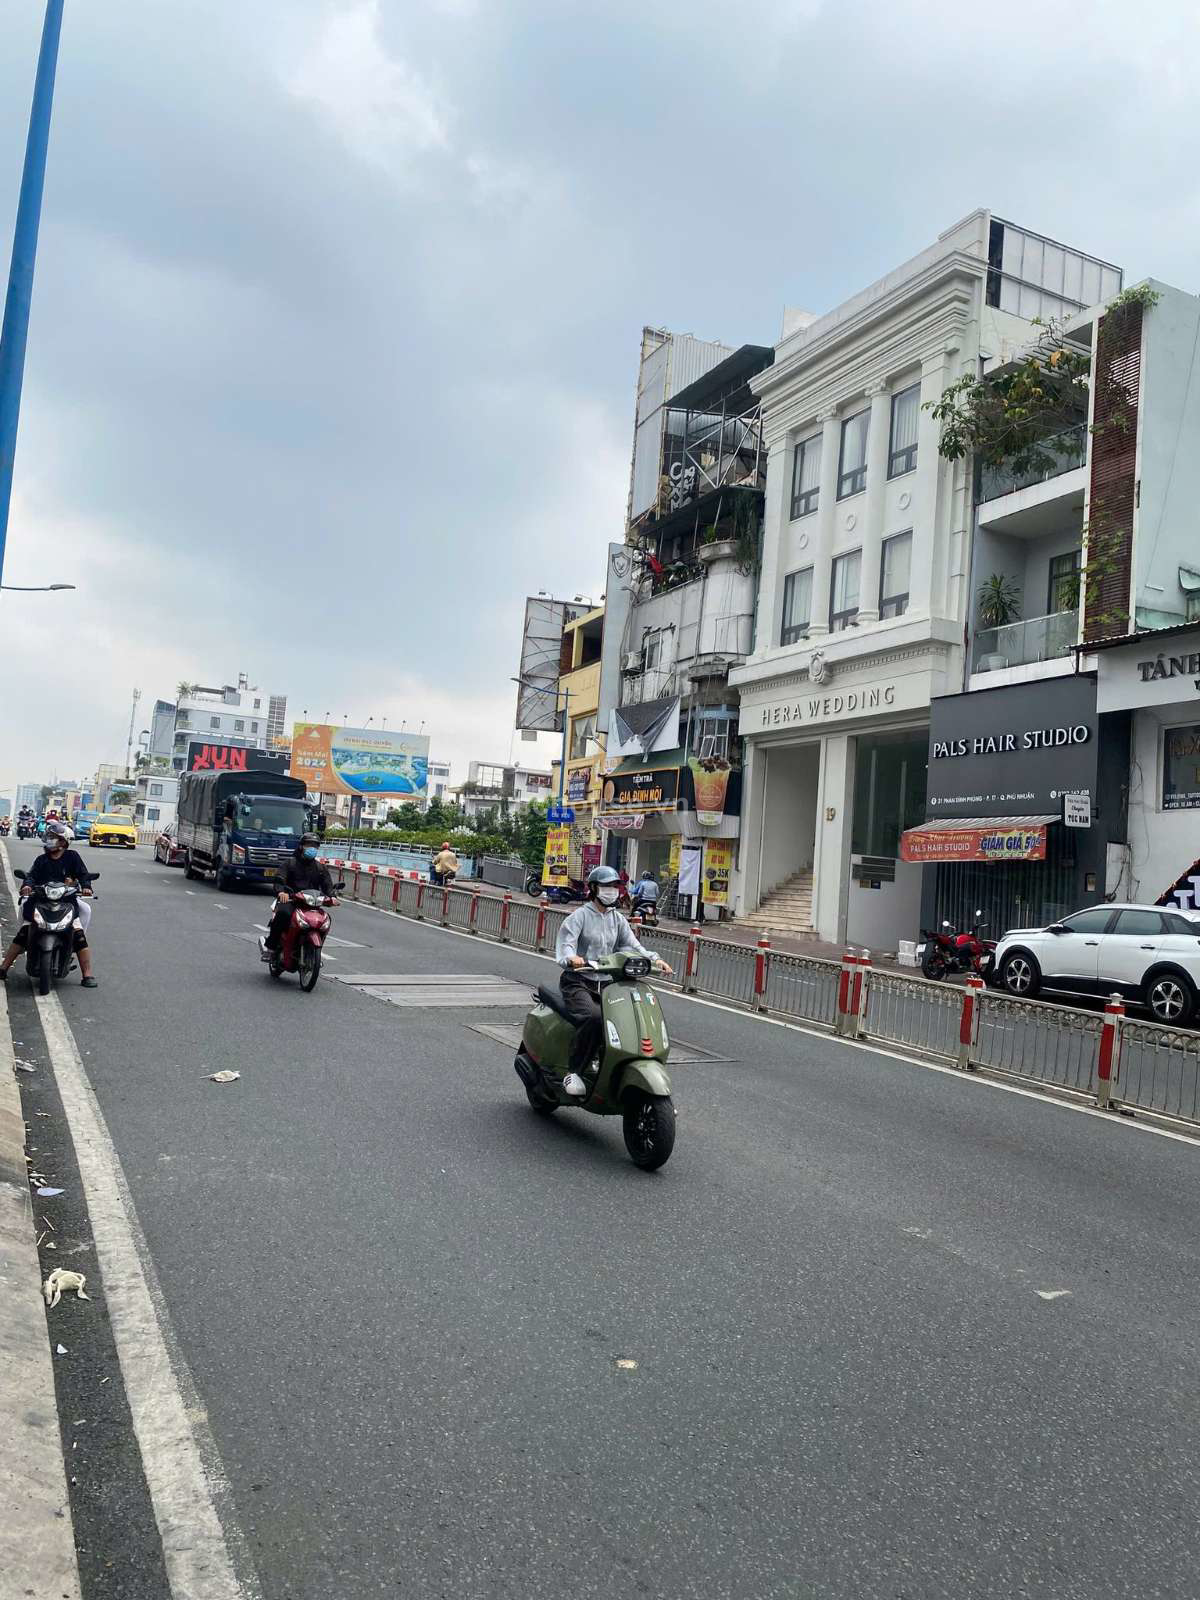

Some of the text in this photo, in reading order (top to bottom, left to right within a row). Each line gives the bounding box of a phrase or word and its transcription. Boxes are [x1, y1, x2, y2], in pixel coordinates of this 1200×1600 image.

[762, 685, 895, 726] HERA WEDDING
[933, 725, 1088, 758] PALS HAIR STUDIO
[296, 757, 327, 768] 2024
[910, 842, 970, 853] PALS HAIR STUDIO
[717, 868, 729, 879] 35K
